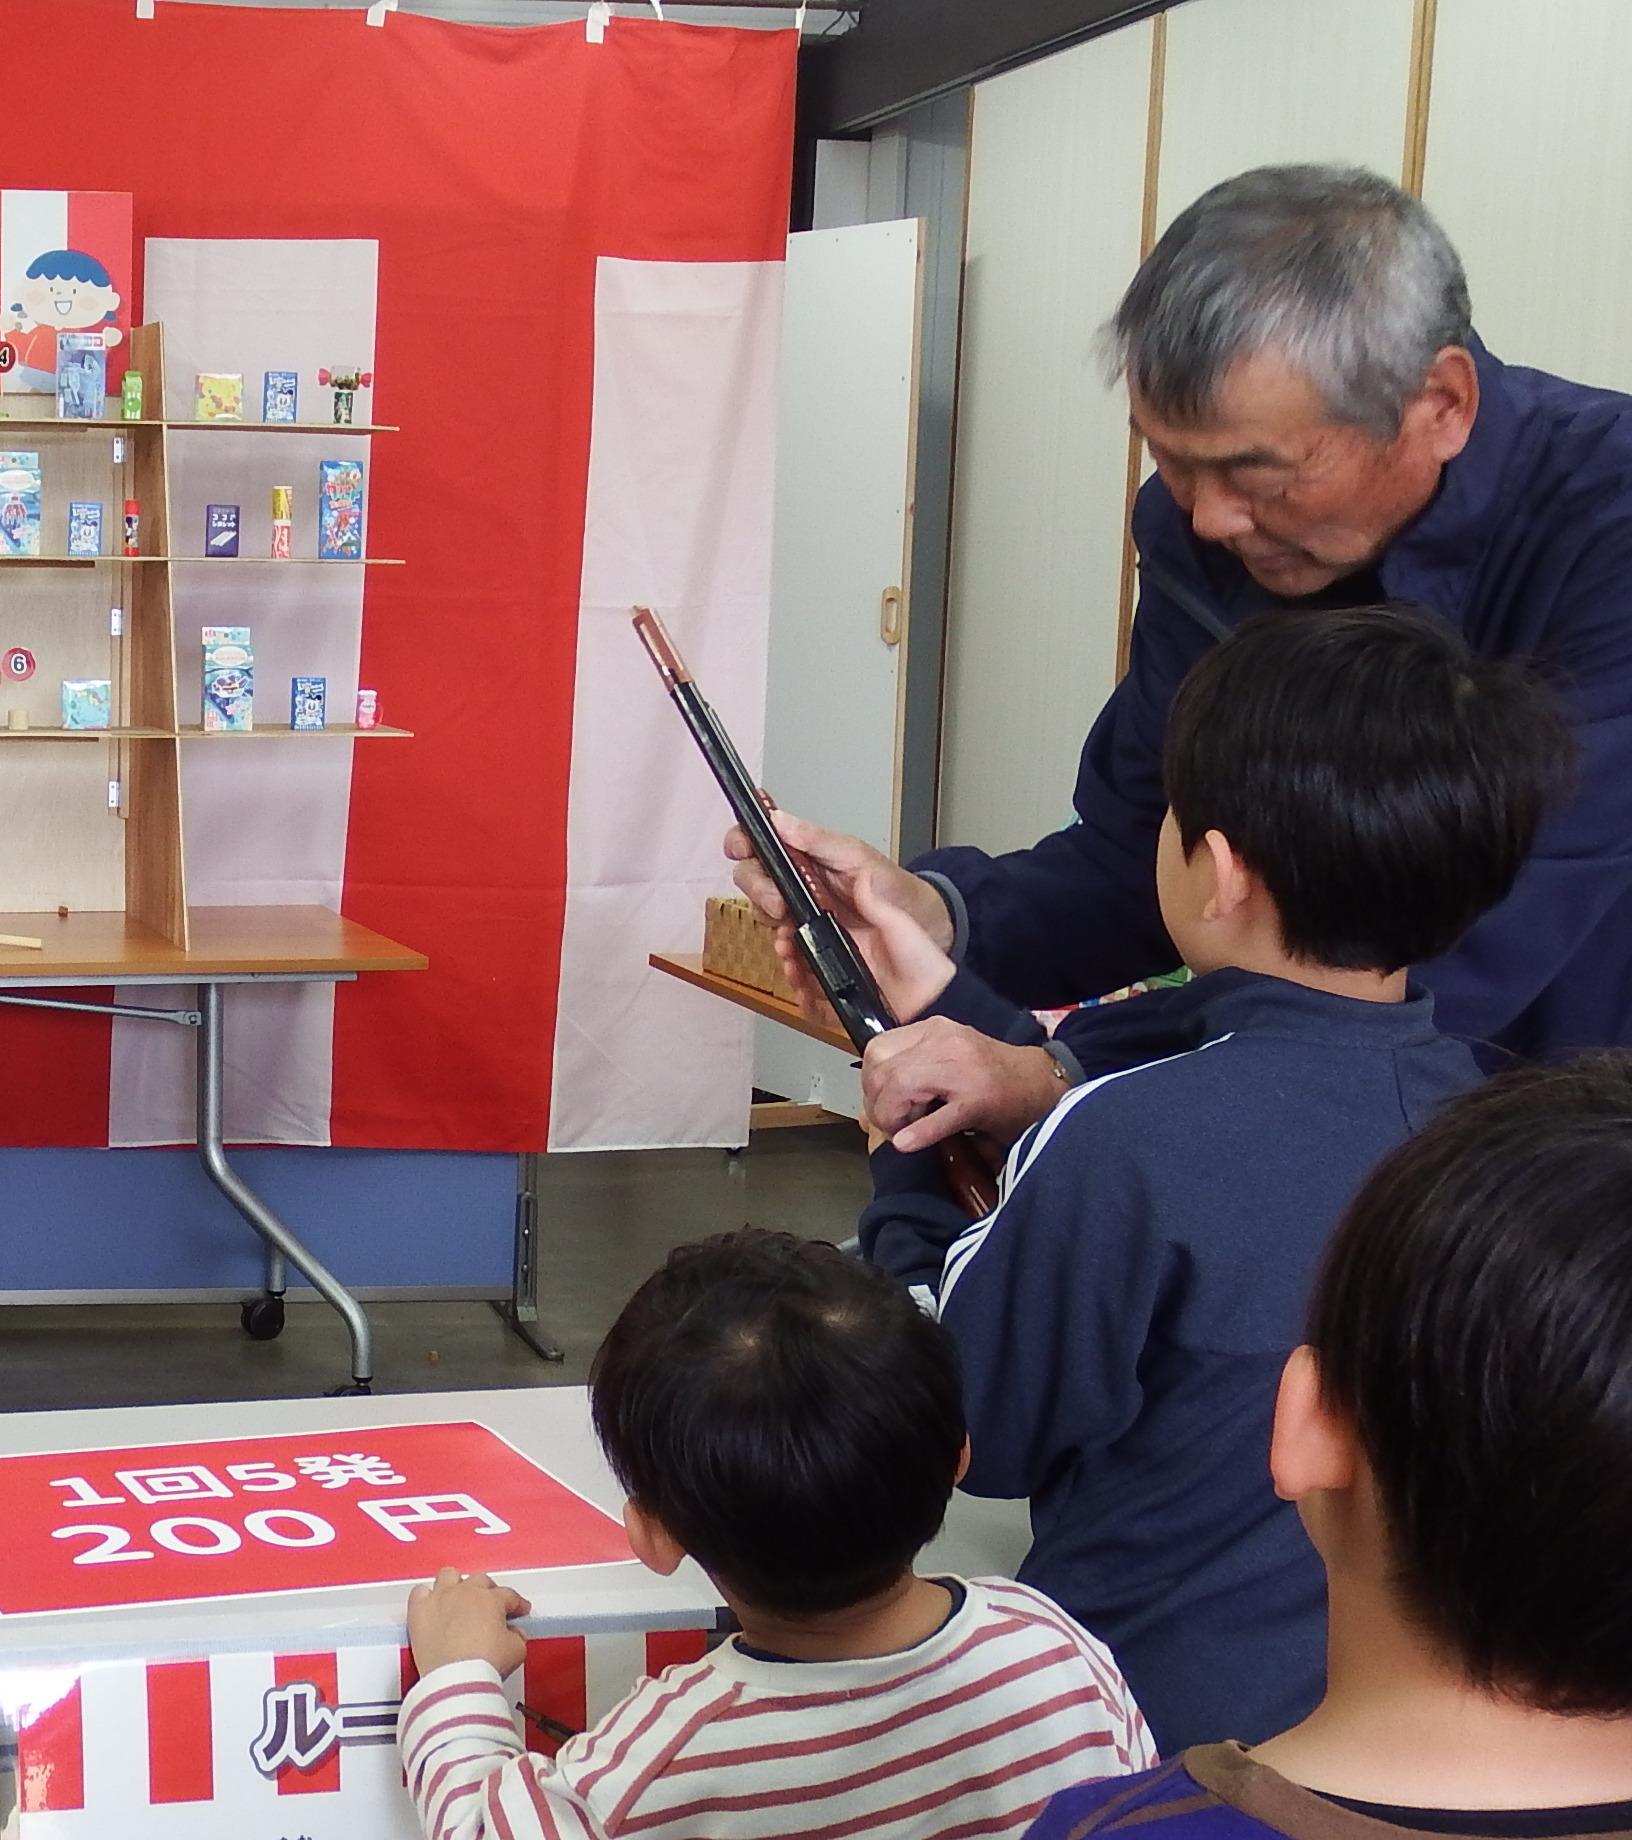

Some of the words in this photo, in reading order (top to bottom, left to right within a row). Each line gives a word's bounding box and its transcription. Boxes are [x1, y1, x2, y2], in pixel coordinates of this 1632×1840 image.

[13, 655, 25, 673] 6
[49, 1453, 406, 1508] 1回5発
[254, 1685, 402, 1768] ルー
